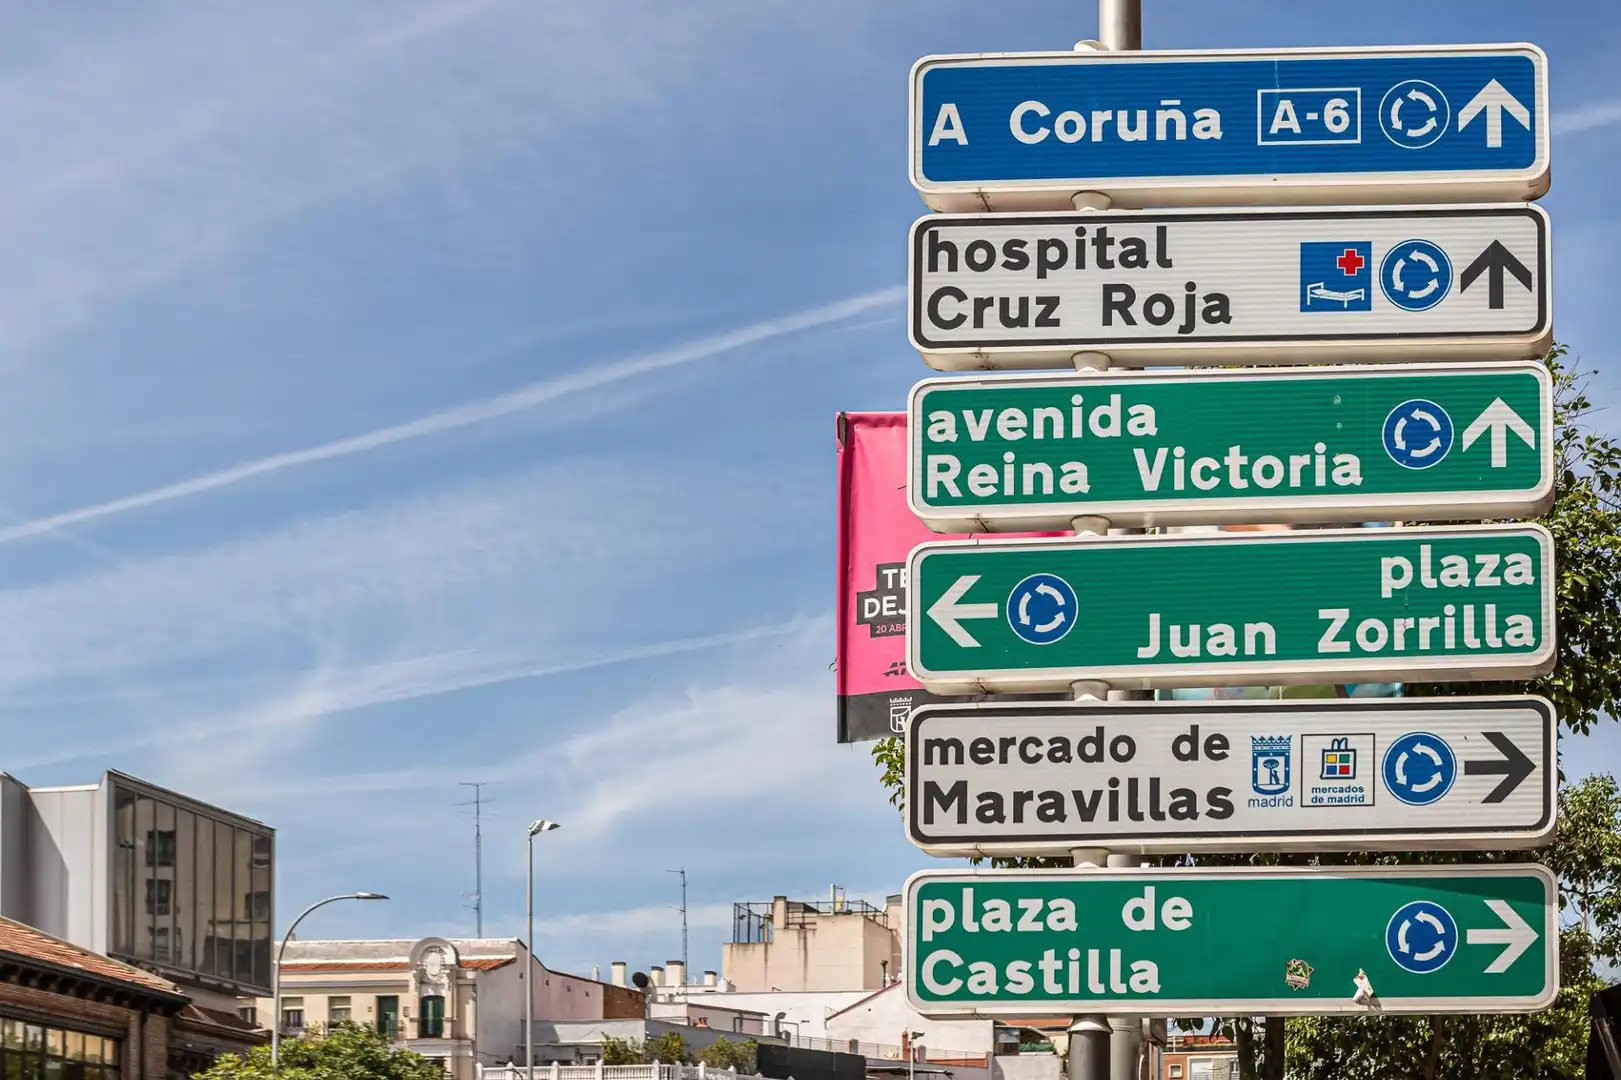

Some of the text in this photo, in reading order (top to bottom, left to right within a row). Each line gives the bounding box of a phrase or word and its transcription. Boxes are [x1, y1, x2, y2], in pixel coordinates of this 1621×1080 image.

[929, 100, 1222, 145] A Coruña
[1270, 99, 1349, 133] A-6
[927, 226, 1172, 279] hospital
[928, 282, 1232, 334] Cruz Roja
[927, 394, 1158, 442] avenida
[928, 442, 1363, 497] Reina Victoria
[1382, 545, 1534, 598] plaza
[875, 625, 887, 634] 20
[1138, 604, 1536, 658] Juan Zorrilla
[924, 725, 1229, 765] mercado de
[924, 777, 1234, 824] Maravillas
[1248, 795, 1293, 808] madrid
[1311, 784, 1364, 794] mercados
[1311, 794, 1365, 804] de madrid
[922, 886, 1192, 941] plaza de
[922, 948, 1160, 995] Castilla
